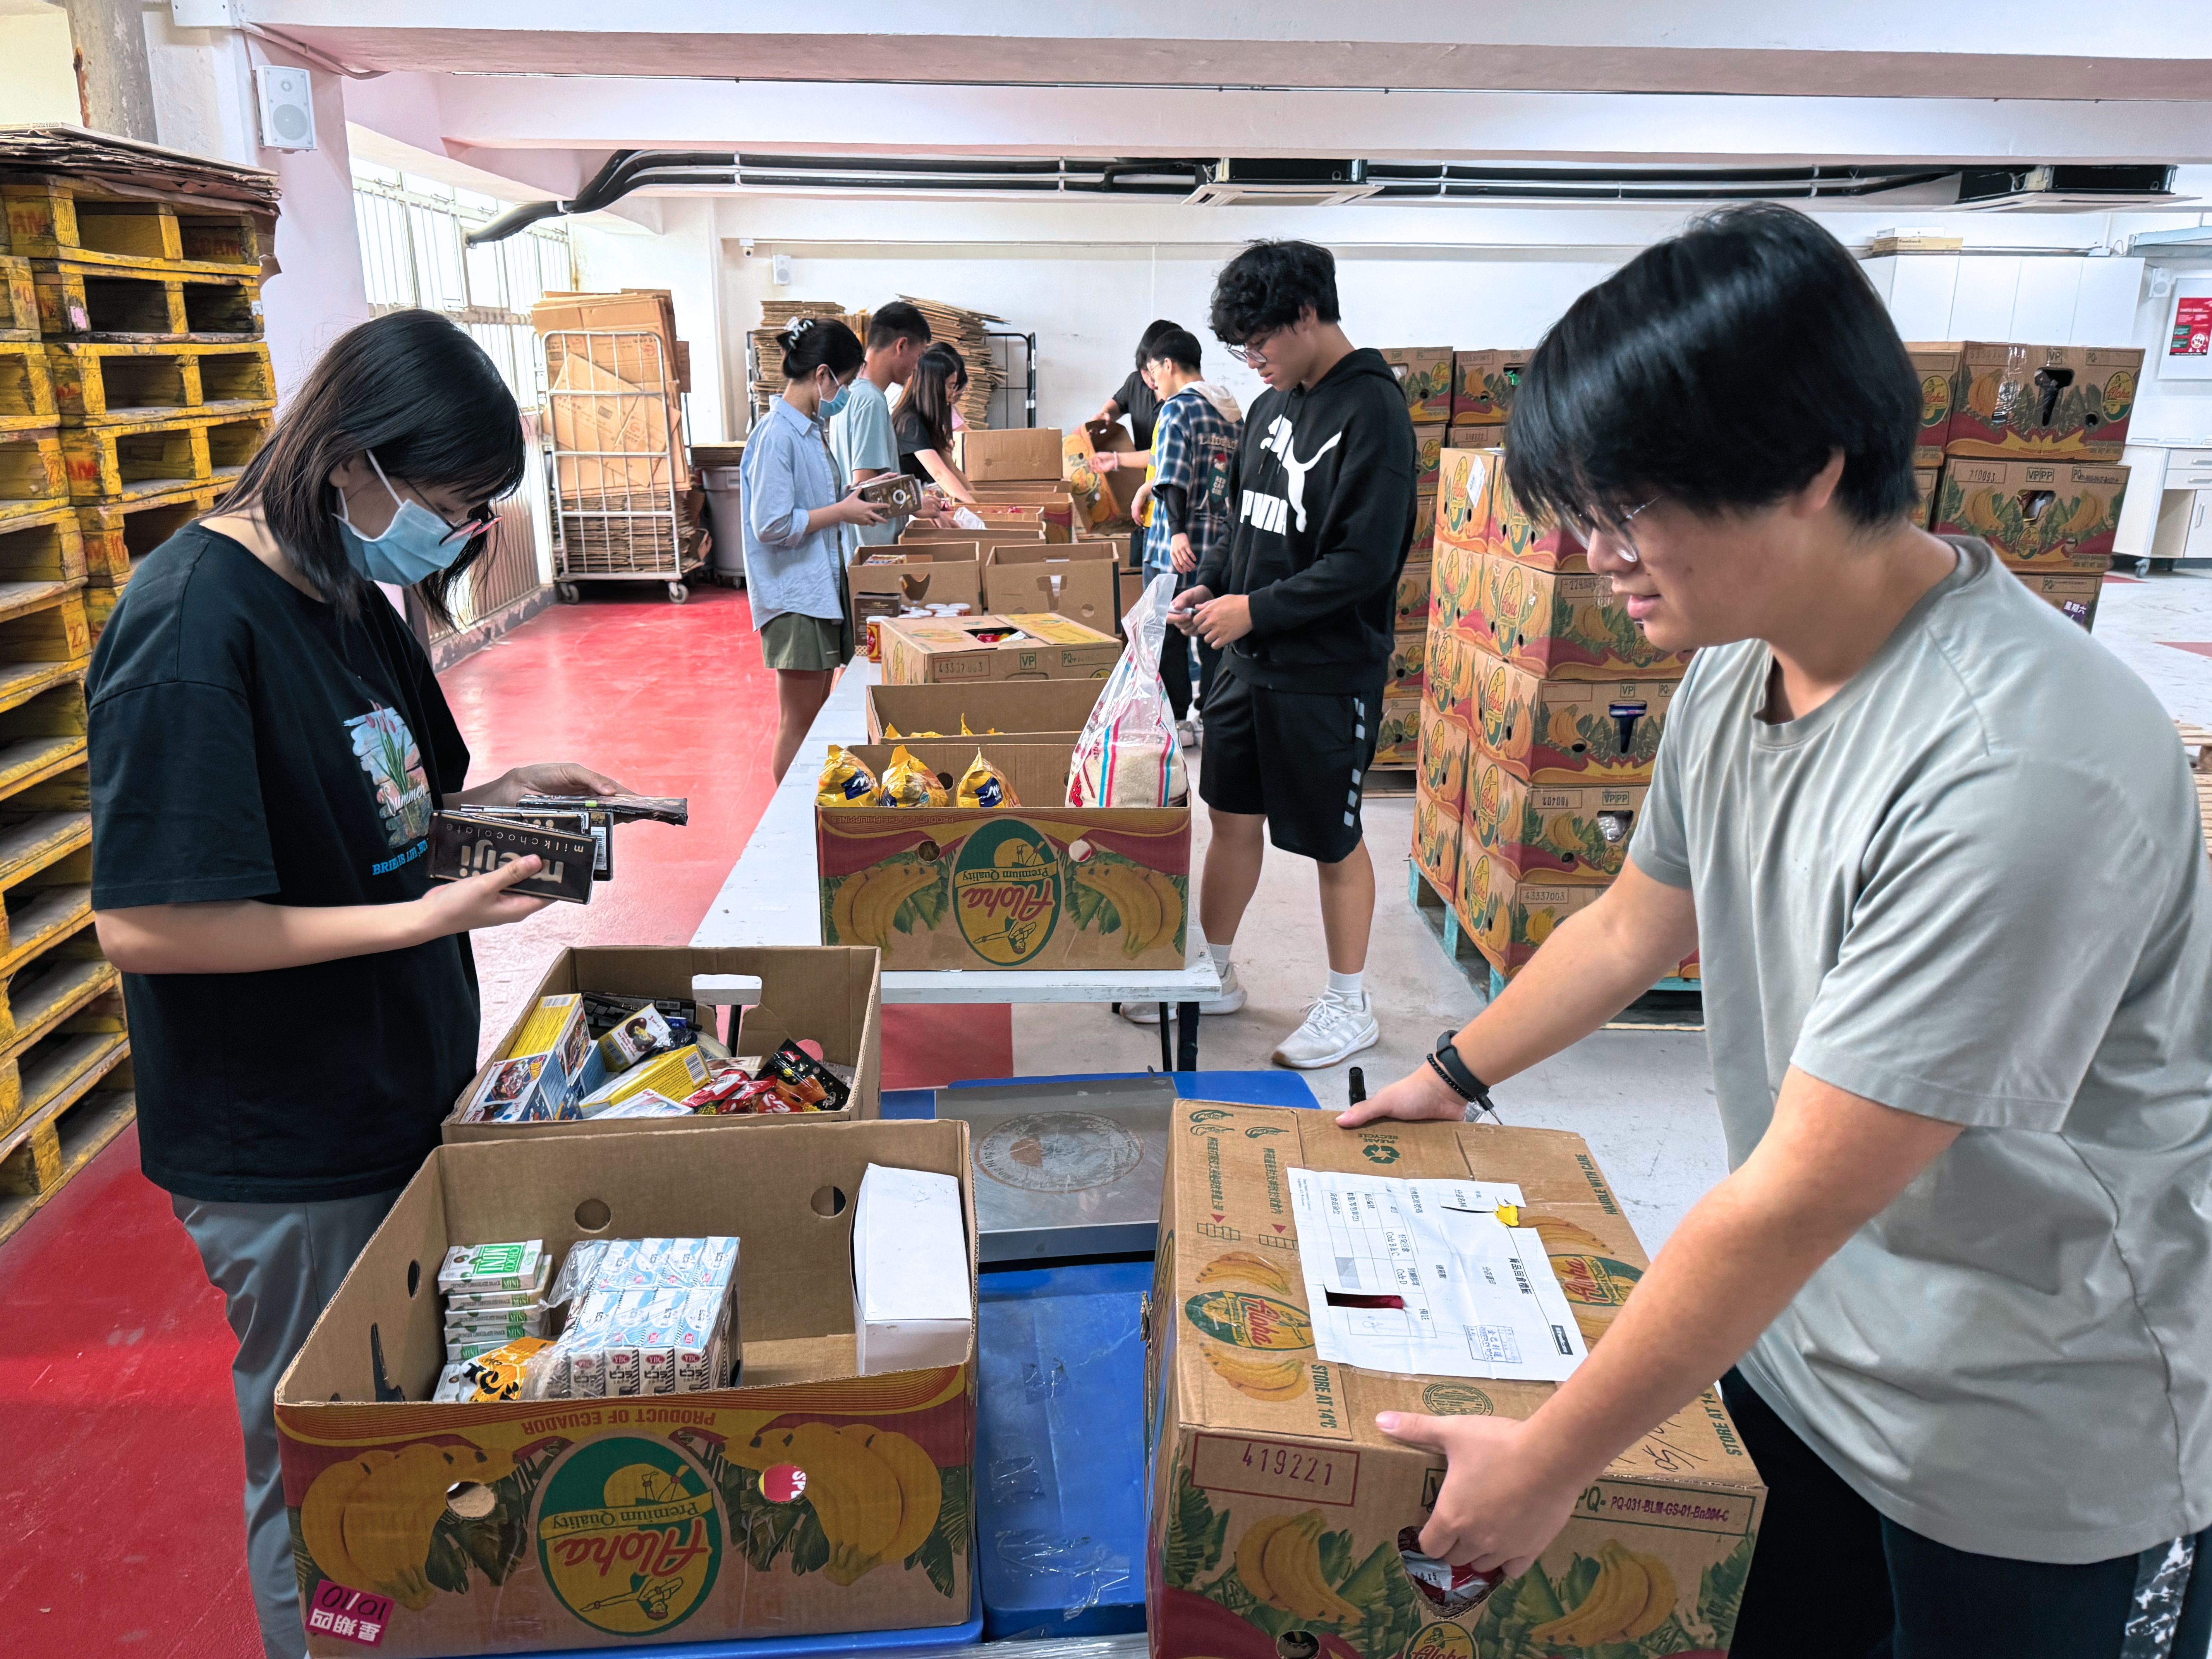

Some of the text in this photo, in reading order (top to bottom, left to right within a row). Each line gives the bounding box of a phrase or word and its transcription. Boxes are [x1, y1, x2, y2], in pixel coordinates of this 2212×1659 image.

[2048, 352, 2061, 361] VP
[2107, 387, 2130, 398] Aloha
[2028, 470, 2052, 480] VP PP
[1240, 489, 1288, 536] PUMA
[1022, 656, 1035, 665] VP
[1622, 686, 1634, 695] VP
[383, 783, 426, 817] Summer
[1481, 788, 1496, 814] Aloha
[447, 823, 584, 853] milk chocolate
[963, 867, 1049, 881] Premium Quality
[962, 880, 1053, 921] Aloha
[1525, 892, 1565, 901] 43337003
[1575, 1154, 1618, 1214] HANDLE WITH CARE
[1386, 1231, 1394, 1243] Code
[477, 1247, 510, 1273] MINI
[504, 1247, 520, 1271] CHOCO
[503, 1279, 520, 1288] MINI
[1396, 1269, 1405, 1280] Code
[1561, 1258, 1610, 1303] Aloha
[512, 1297, 528, 1305] MINI
[510, 1313, 527, 1322] MINI
[1240, 1297, 1281, 1345] Aloha
[508, 1329, 525, 1337] MINI
[1311, 1364, 1331, 1392] STORE
[1316, 1394, 1333, 1407] AT
[1705, 1407, 1725, 1420] AT
[521, 1409, 716, 1435] PRODUCT OF ECUADOR
[1713, 1422, 1743, 1456] STORE
[1242, 1443, 1333, 1486] 419221
[553, 1502, 697, 1532] Premium Quality
[554, 1519, 709, 1577] Aloha
[321, 1586, 386, 1621] 10/10
[309, 1608, 381, 1642] 星期四
